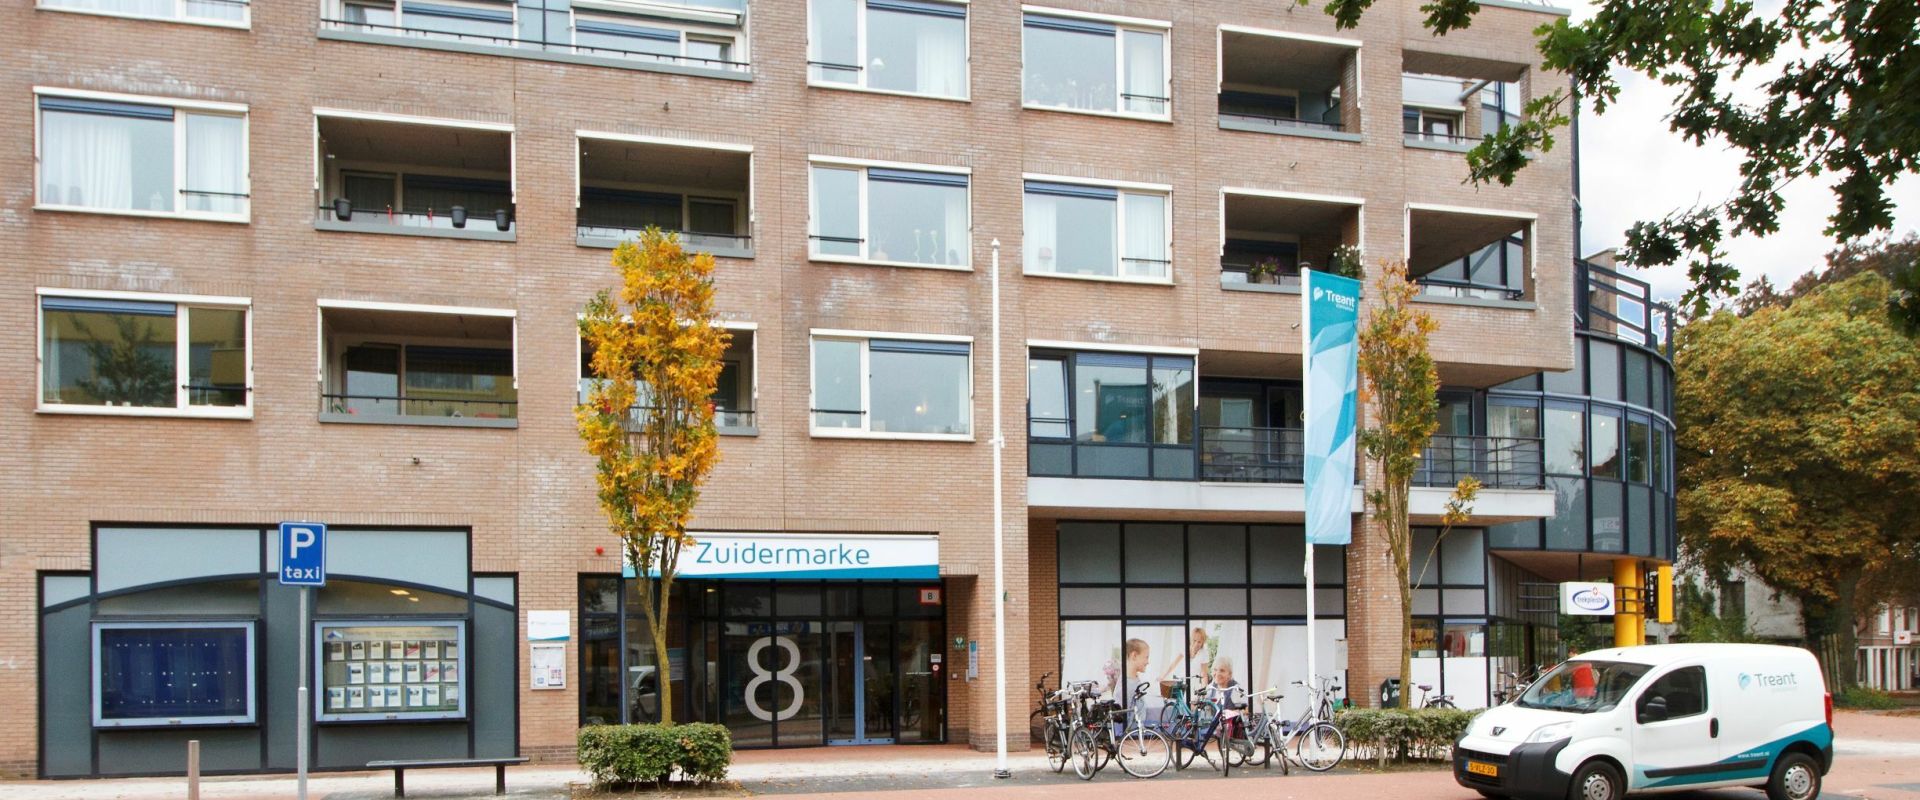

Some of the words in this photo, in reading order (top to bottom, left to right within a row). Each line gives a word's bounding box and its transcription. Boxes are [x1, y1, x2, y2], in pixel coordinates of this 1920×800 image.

[1325, 289, 1355, 307] Treant
[291, 527, 316, 559] P
[696, 542, 870, 565] Zuidermarke
[285, 565, 320, 579] taxi
[744, 636, 804, 721] 8
[1754, 672, 1797, 687] Treant
